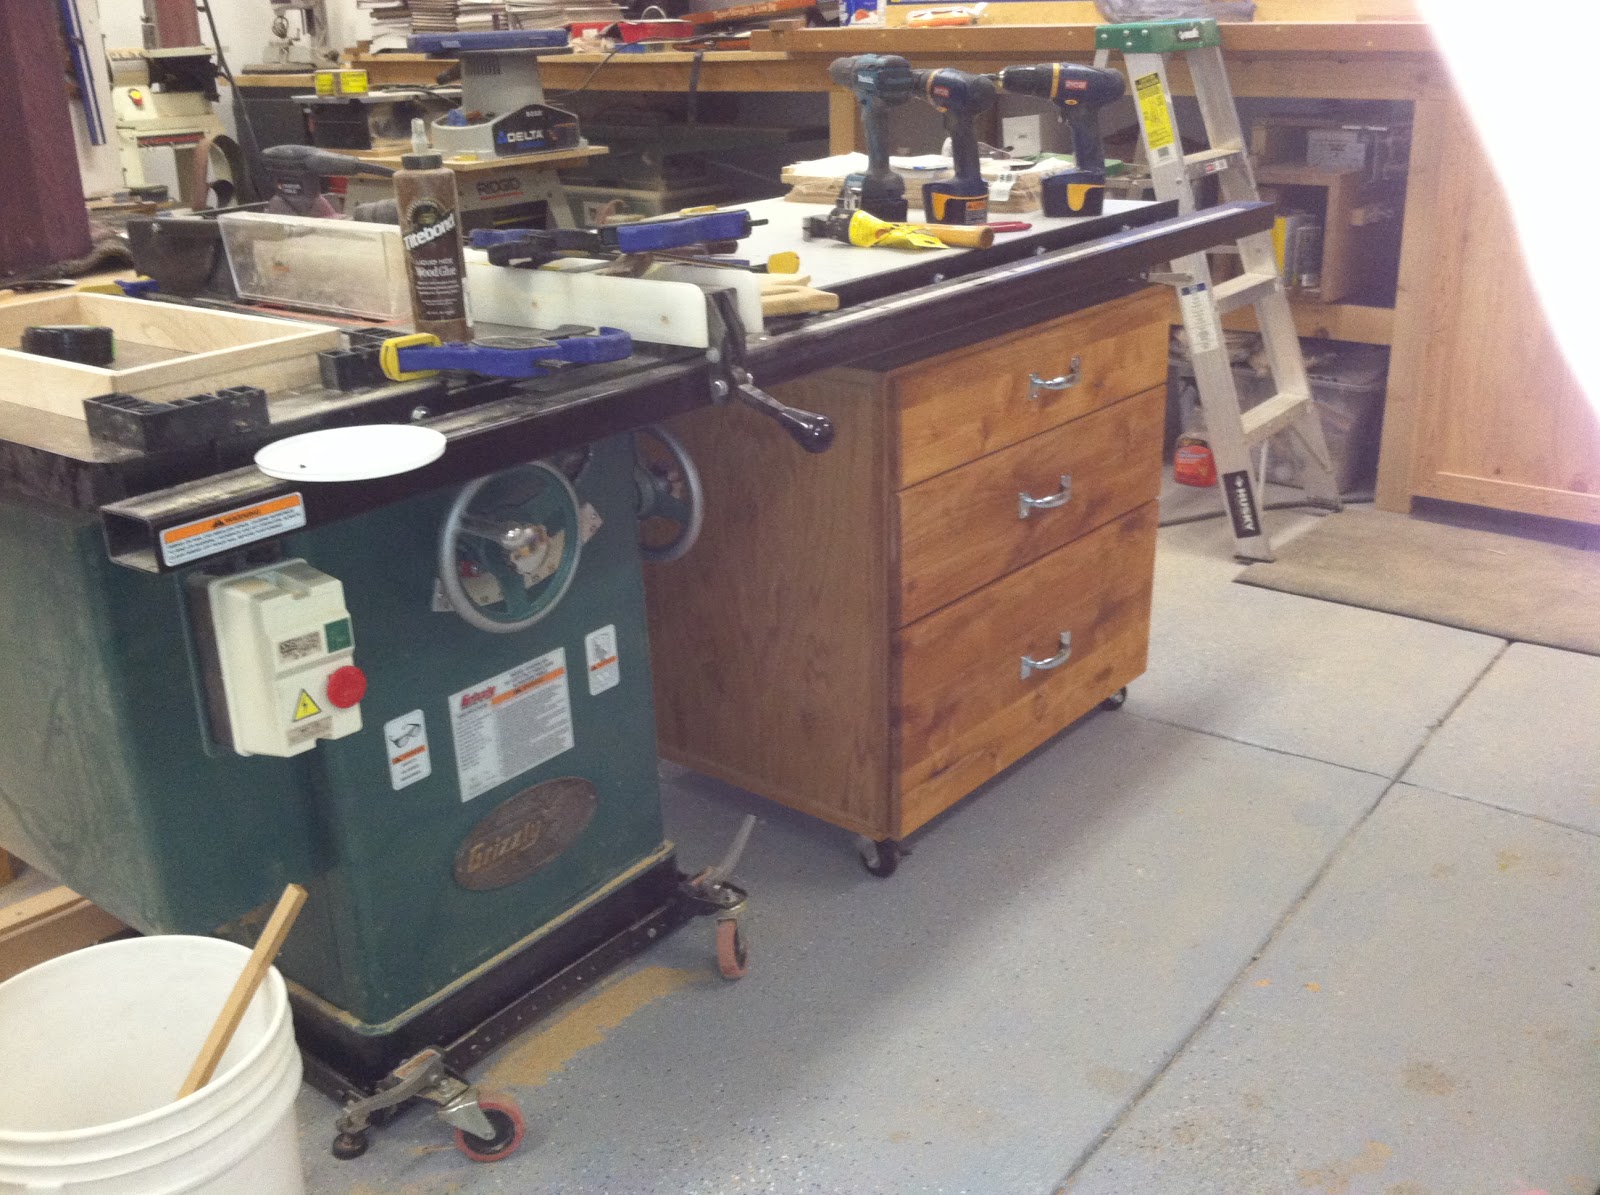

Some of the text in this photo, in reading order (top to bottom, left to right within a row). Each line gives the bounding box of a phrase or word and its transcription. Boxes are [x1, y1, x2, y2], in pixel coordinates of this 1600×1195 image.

[506, 129, 545, 143] DELTA
[403, 212, 456, 252] Titebond
[467, 820, 542, 874] Grizzly
